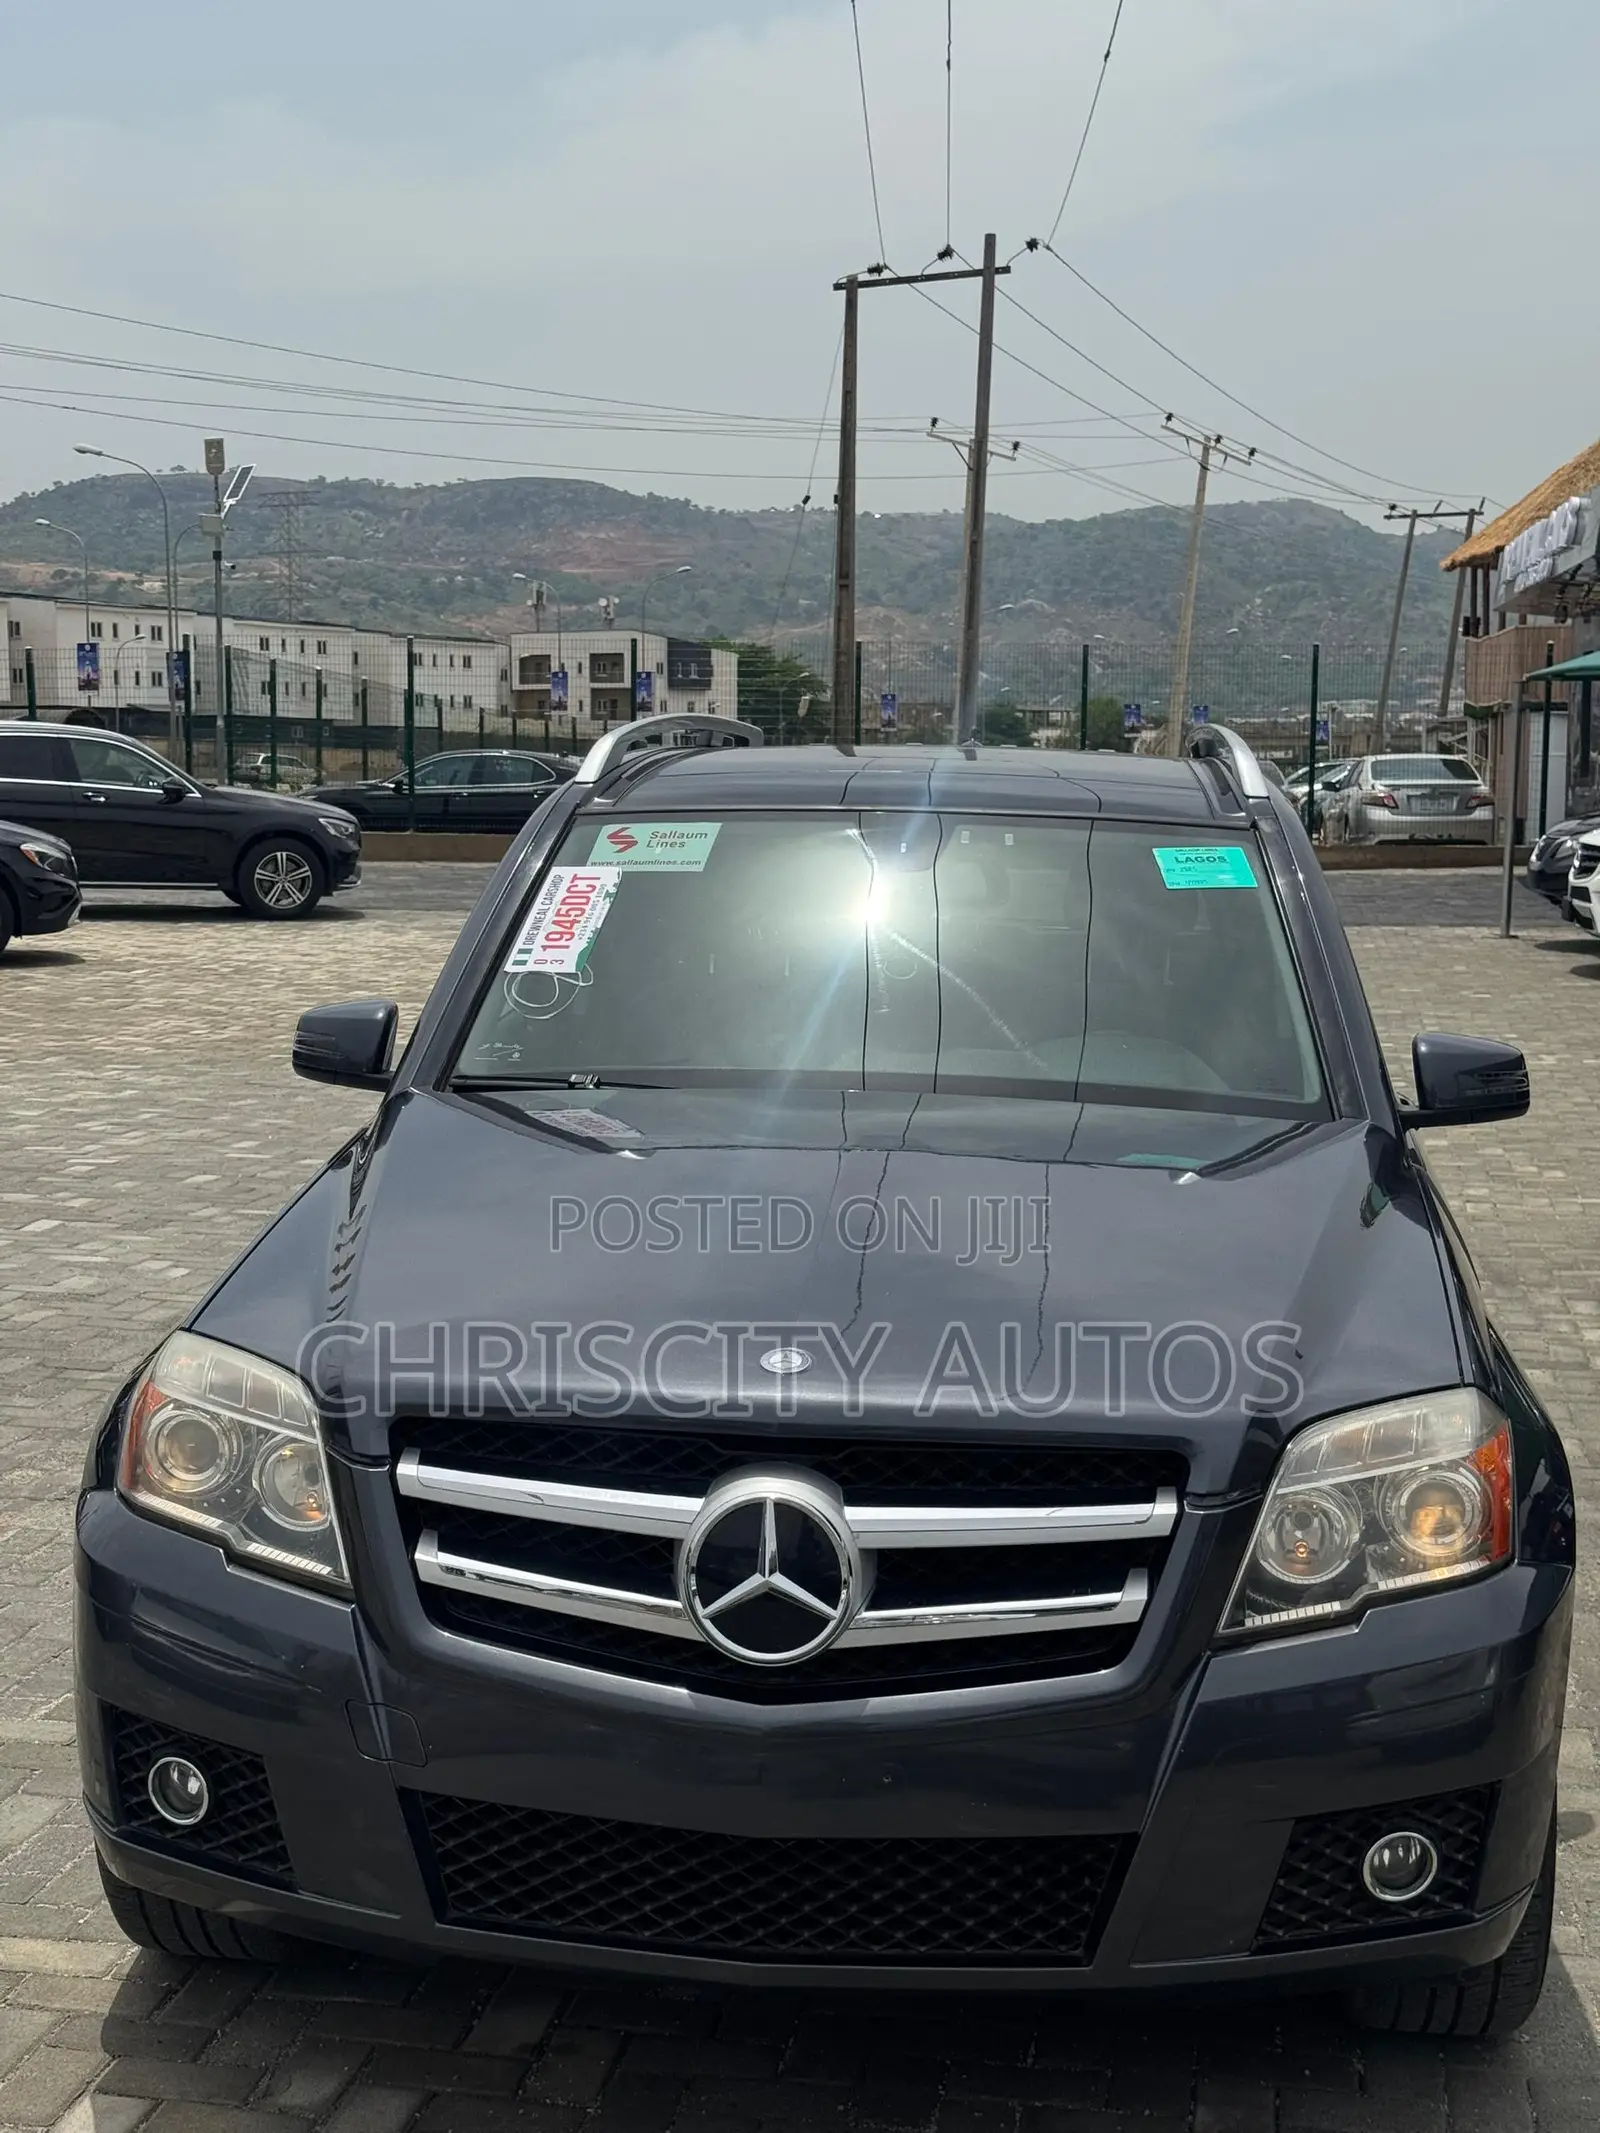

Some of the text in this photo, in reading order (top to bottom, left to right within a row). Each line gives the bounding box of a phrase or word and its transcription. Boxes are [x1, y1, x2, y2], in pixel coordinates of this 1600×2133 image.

[649, 830, 708, 840] Sallaum
[646, 839, 687, 849] Lines
[590, 859, 701, 867] www.sallaumlines.com
[1174, 855, 1229, 864] LAGOS
[523, 874, 564, 946] DREWNEAL CARSHOP
[541, 873, 601, 952] 1945DCT
